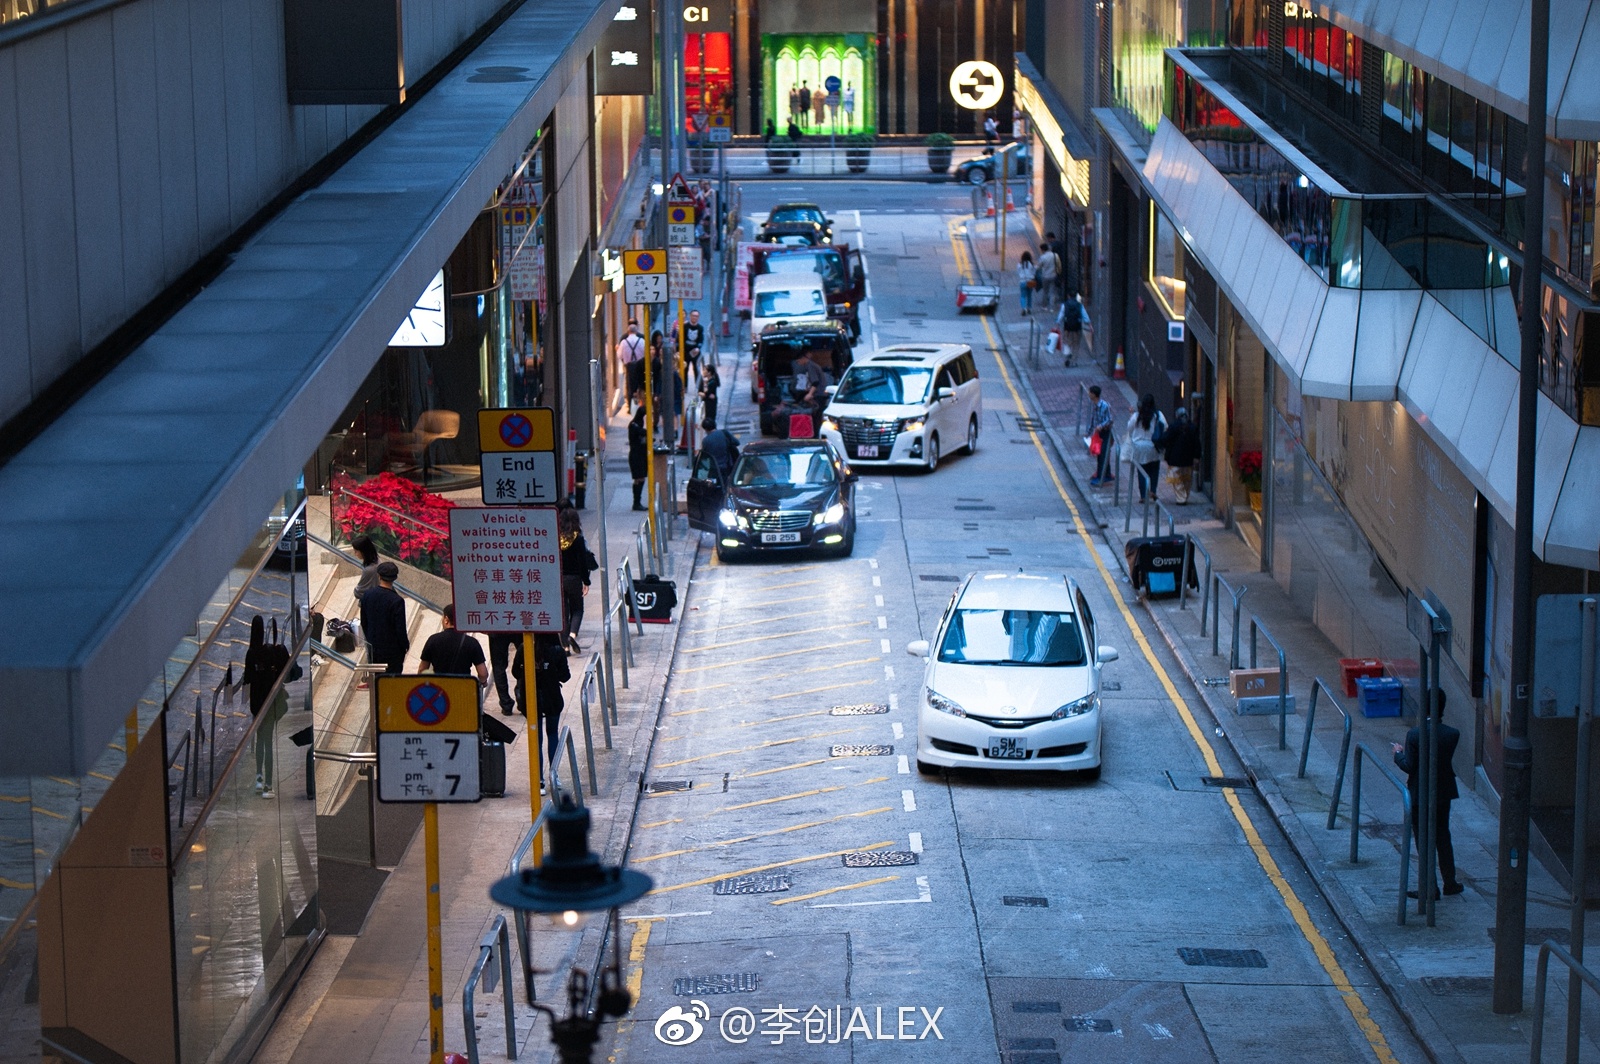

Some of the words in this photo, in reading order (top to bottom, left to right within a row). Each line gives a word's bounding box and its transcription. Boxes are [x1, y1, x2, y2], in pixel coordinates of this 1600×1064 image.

[652, 276, 659, 286] 7
[652, 291, 660, 301] 7
[502, 457, 535, 471] End
[496, 477, 545, 499] 終止
[482, 513, 526, 524] Vehicle
[462, 527, 506, 537] waiting
[510, 527, 531, 537] will
[534, 527, 548, 537] be
[765, 534, 777, 542] GB
[779, 534, 796, 542] 255
[472, 540, 539, 551] prosecuted
[457, 553, 504, 563] without
[507, 553, 555, 564] warning
[473, 568, 542, 583] 停車等候
[475, 589, 543, 605] 會被檢控
[467, 610, 552, 626] 而不予警告
[404, 736, 422, 745] am
[1000, 738, 1016, 748] SM
[400, 747, 428, 761] 上午
[444, 738, 460, 761] 7
[991, 747, 1023, 757] 8725
[405, 772, 423, 783] pm
[400, 784, 428, 796] 下午
[445, 774, 461, 796] 7
